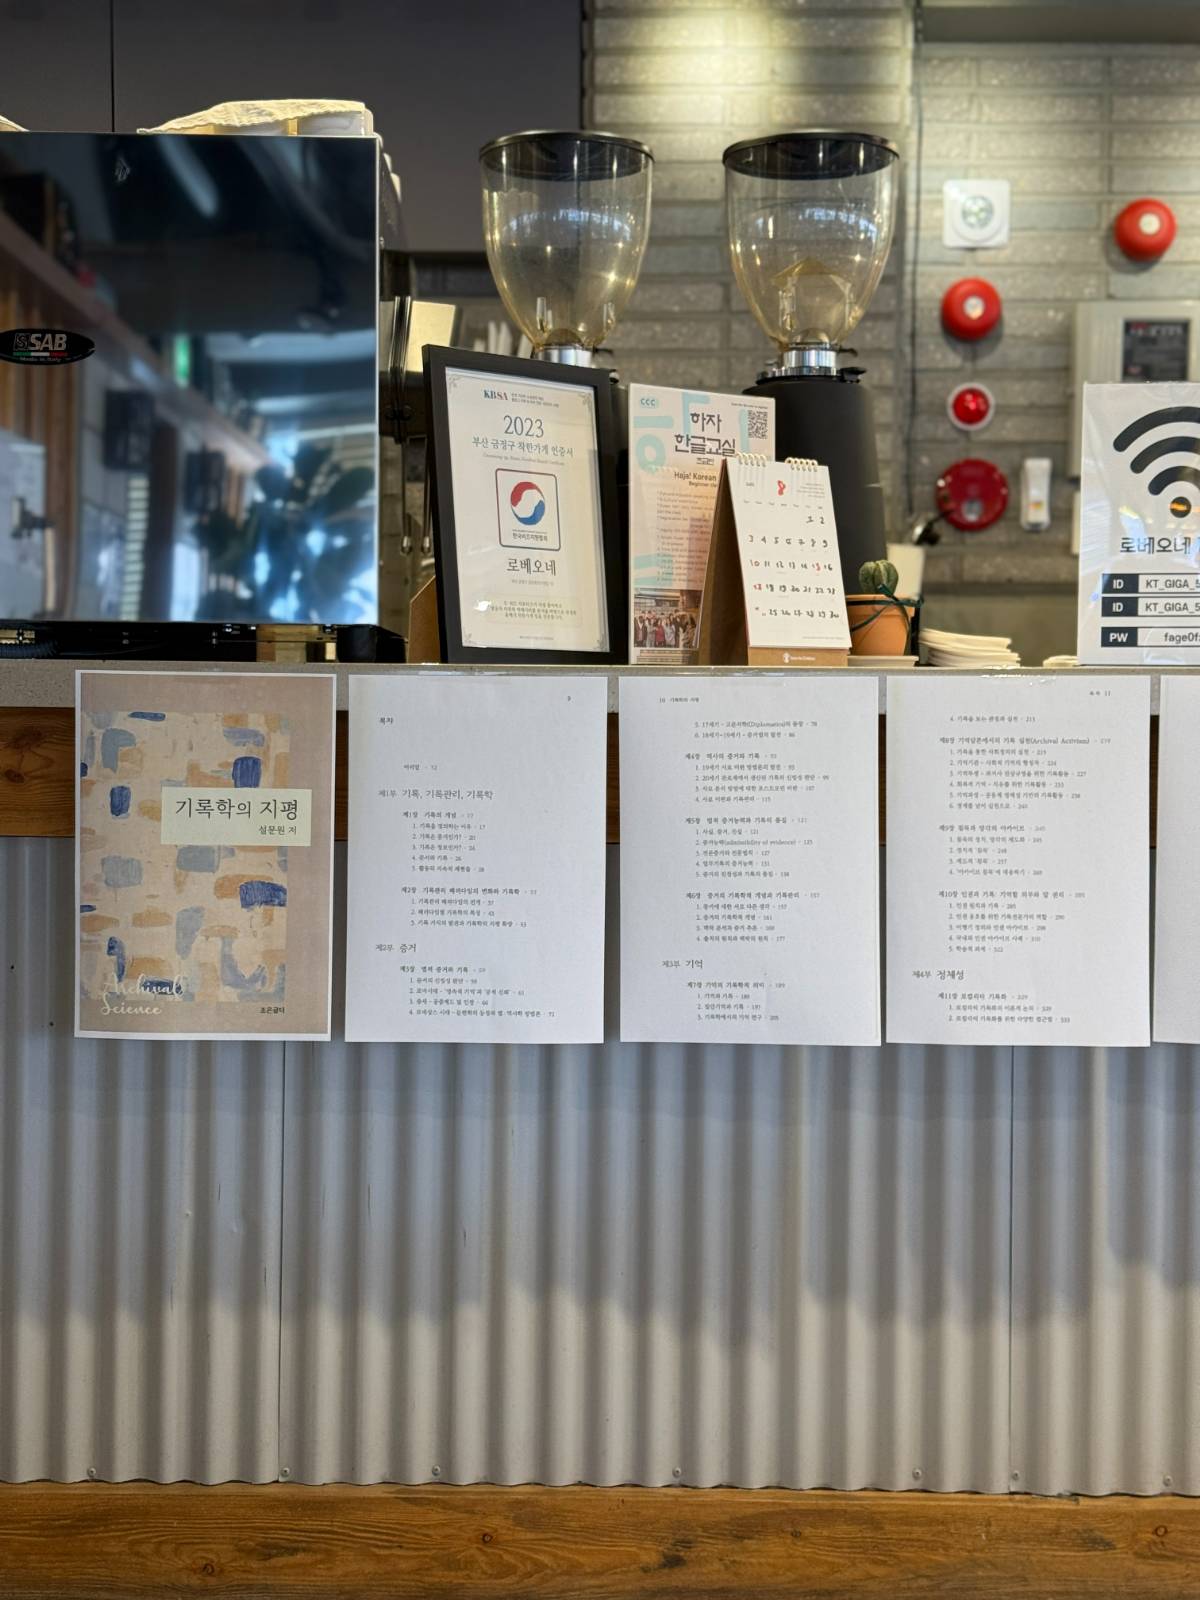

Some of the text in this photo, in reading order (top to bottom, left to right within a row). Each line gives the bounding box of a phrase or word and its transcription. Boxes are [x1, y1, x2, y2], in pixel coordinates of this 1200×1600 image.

[484, 389, 508, 400] KBSA
[503, 414, 544, 438] 2023
[690, 412, 722, 433] 하자
[472, 437, 574, 458] 부산 금정구 착한가게 인증서
[674, 433, 736, 456] 한글교실
[693, 473, 717, 481] Korean
[777, 480, 786, 496] 8
[761, 536, 766, 544] 4
[822, 540, 828, 548] 9
[1120, 537, 1191, 554] 로베오네
[507, 558, 556, 576] 로베오네
[812, 563, 820, 571] 15
[1113, 579, 1124, 589] ID
[1112, 603, 1124, 612] ID
[1110, 632, 1200, 644] PW fage0f
[404, 789, 422, 798] 기록,
[427, 790, 463, 799] 기록관리,
[467, 790, 492, 798] 기록학
[175, 798, 298, 820] 기록학의 지평
[258, 824, 297, 836] 설문원 저
[400, 943, 416, 952] 증거
[686, 960, 702, 968] 기억
[938, 970, 963, 979] 정체성
[102, 972, 184, 1000] Archival
[101, 994, 162, 1016] Science
